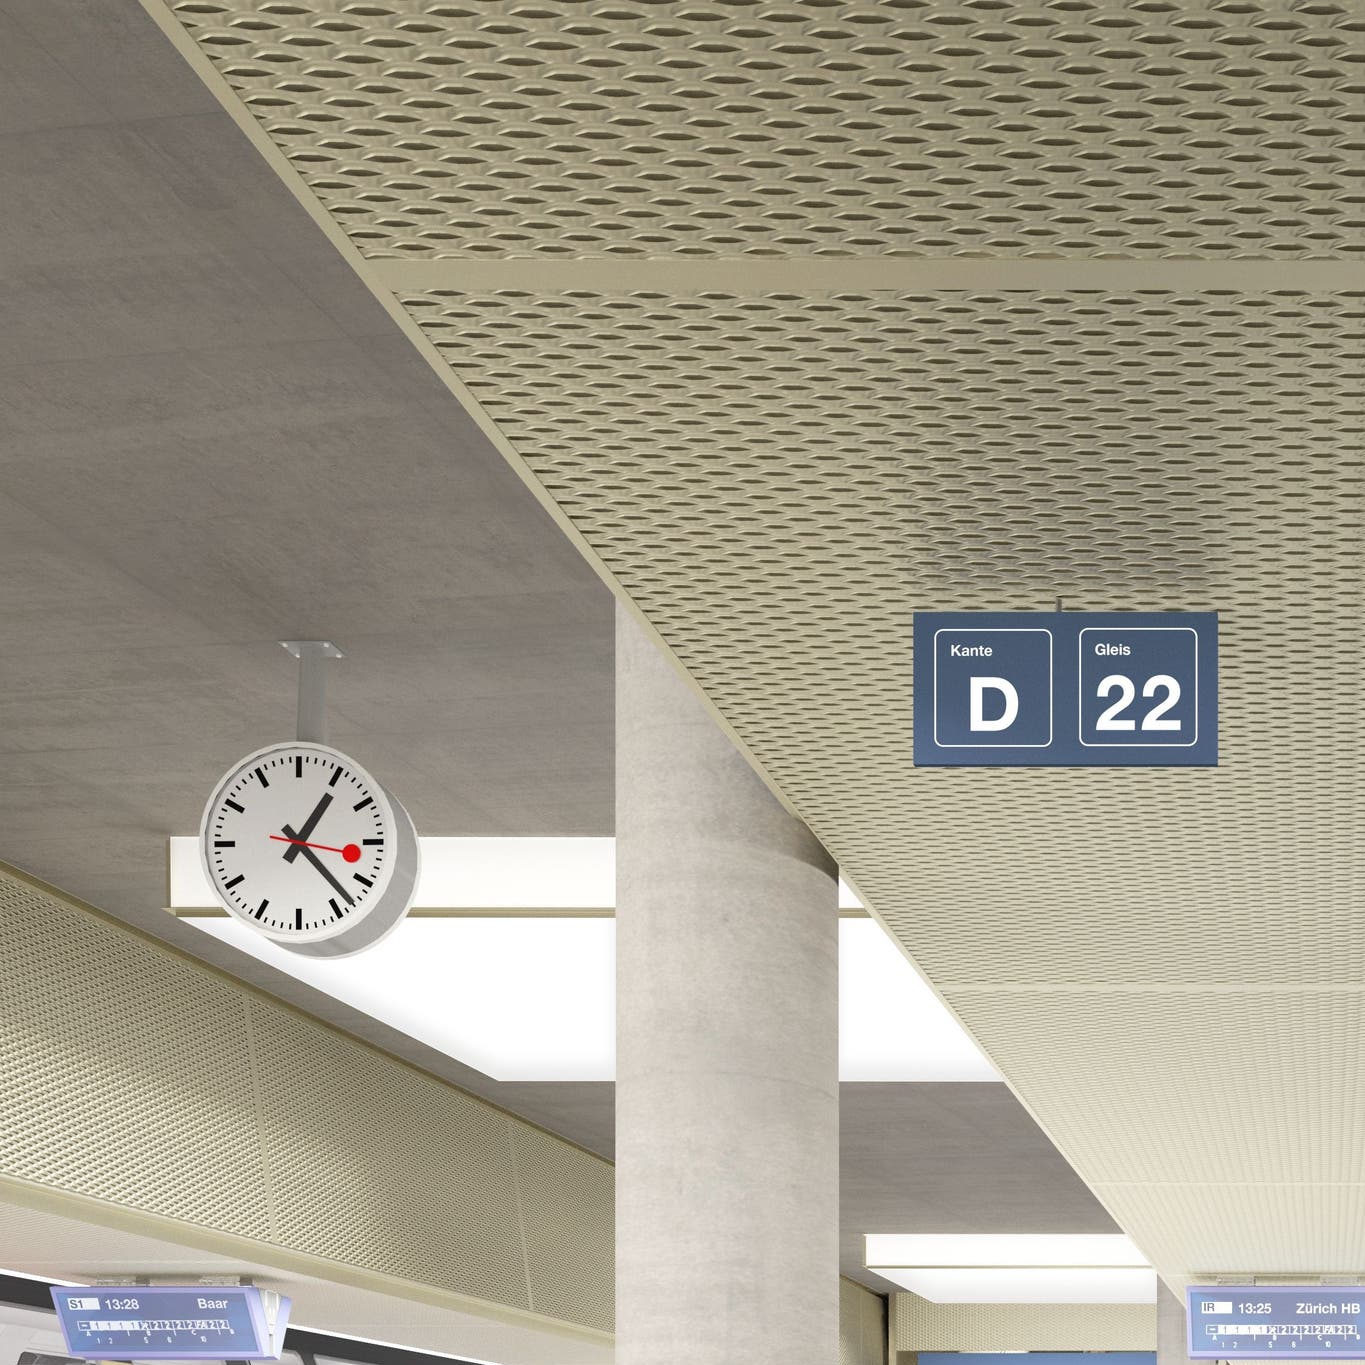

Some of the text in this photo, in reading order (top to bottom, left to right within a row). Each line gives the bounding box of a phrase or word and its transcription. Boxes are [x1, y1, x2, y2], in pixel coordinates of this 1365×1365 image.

[950, 644, 993, 657] Kante
[1095, 643, 1131, 656] Gleis
[970, 676, 1019, 732] D
[1096, 674, 1182, 731] 22
[69, 1298, 228, 1310] S1 13:28 Baar
[1203, 1302, 1361, 1314] IR 13:25 Zürich HB
